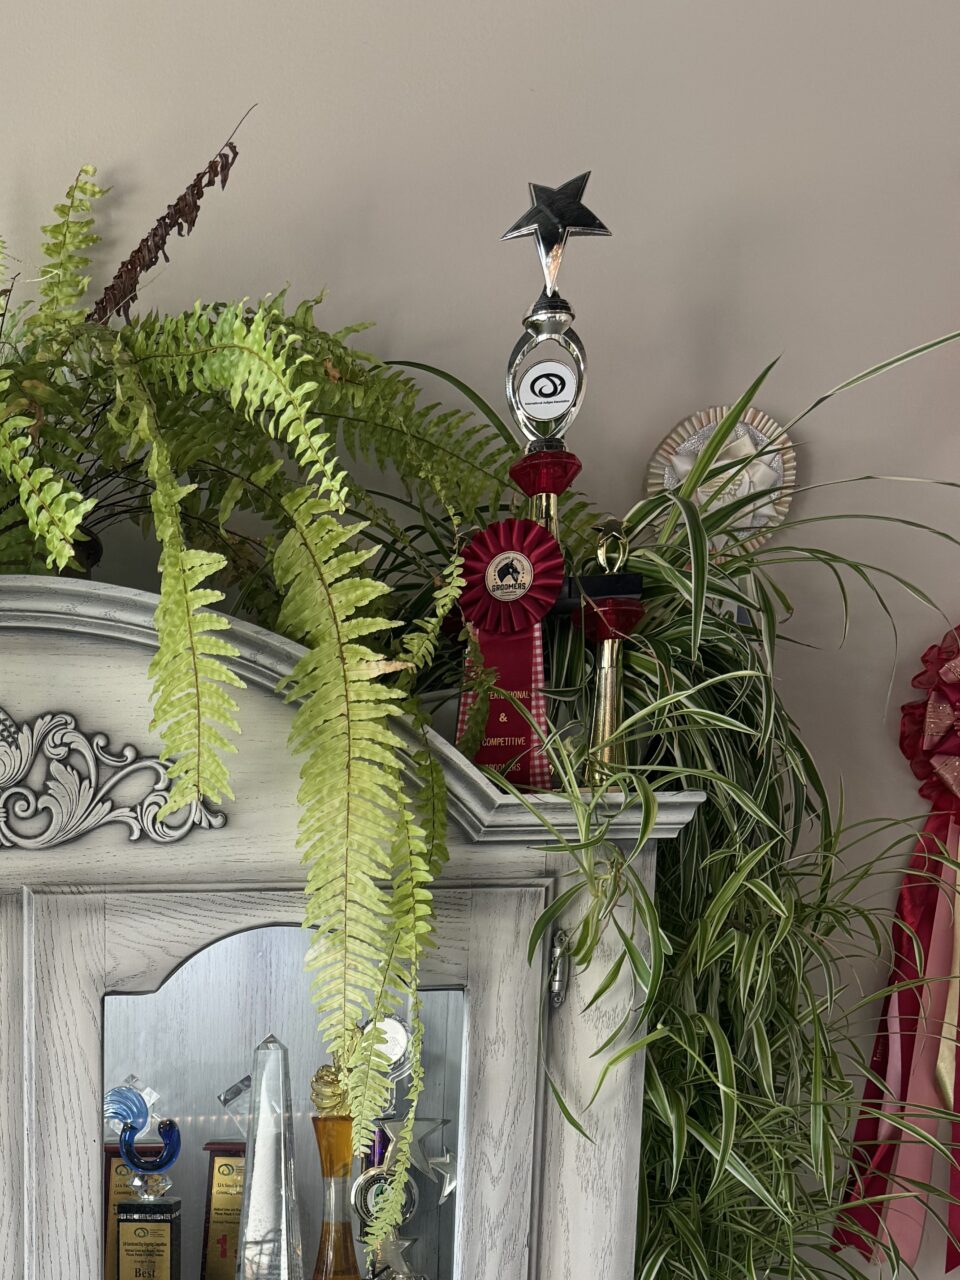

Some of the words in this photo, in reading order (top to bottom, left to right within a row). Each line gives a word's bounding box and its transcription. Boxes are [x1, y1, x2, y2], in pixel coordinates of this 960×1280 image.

[491, 582, 526, 592] GROOMERS
[499, 712, 508, 722] &
[481, 737, 526, 746] COMPETITIVE
[135, 1268, 156, 1278] Best
